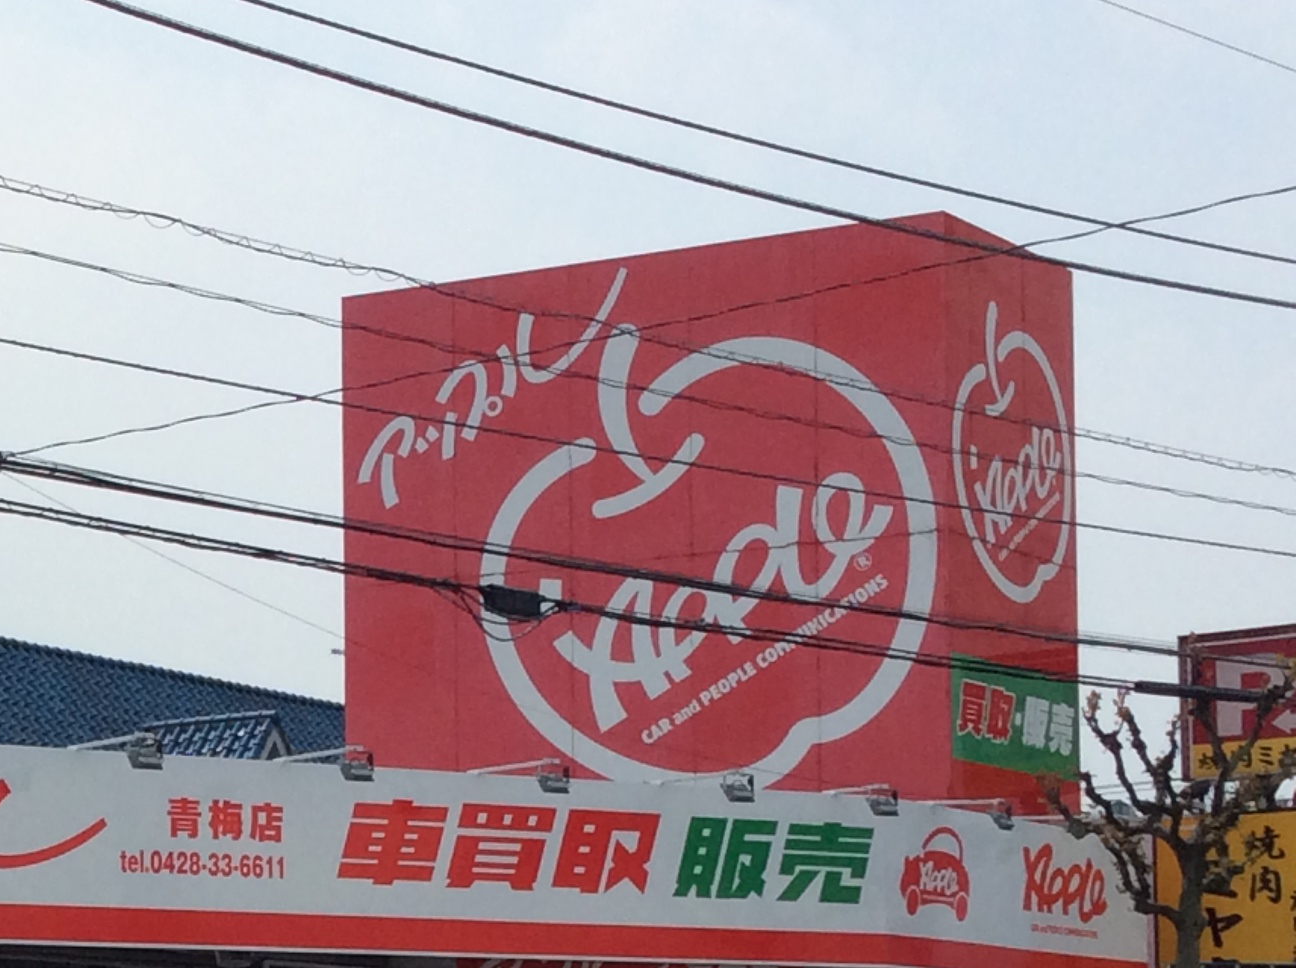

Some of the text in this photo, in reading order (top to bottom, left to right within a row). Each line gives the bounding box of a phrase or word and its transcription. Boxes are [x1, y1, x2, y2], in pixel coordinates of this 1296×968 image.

[358, 267, 627, 509] アップル
[641, 717, 673, 745] CAR
[672, 699, 701, 725] and
[699, 661, 757, 708] PEOPLE
[1214, 652, 1290, 737] P
[167, 797, 283, 843] 青梅店
[336, 798, 876, 905] 車買取 販売
[1022, 842, 1108, 924] Apple
